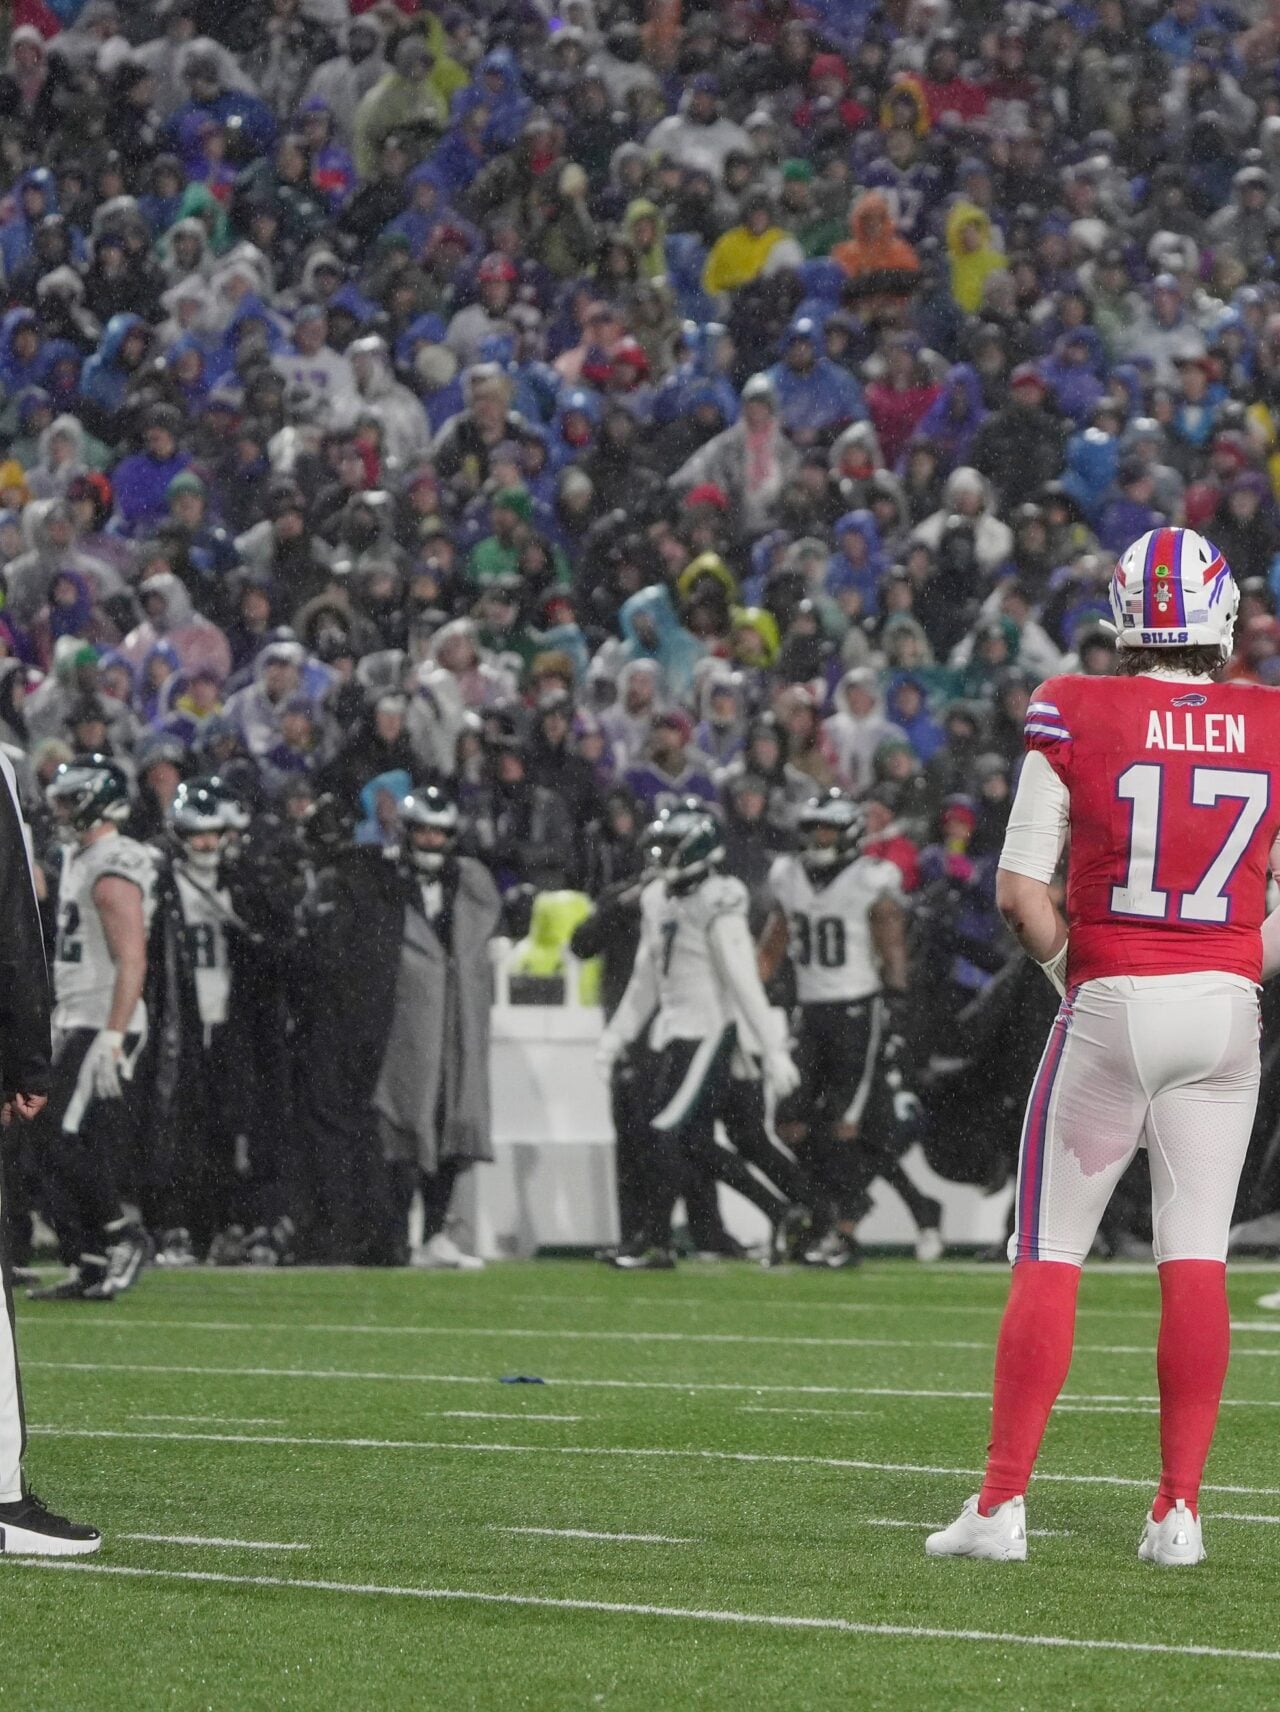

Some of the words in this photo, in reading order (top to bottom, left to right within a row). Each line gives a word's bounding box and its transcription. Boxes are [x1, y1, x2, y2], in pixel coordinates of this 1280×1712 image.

[1141, 631, 1188, 644] BILLS
[1145, 709, 1246, 753] ALLEN
[1109, 761, 1270, 923] 17
